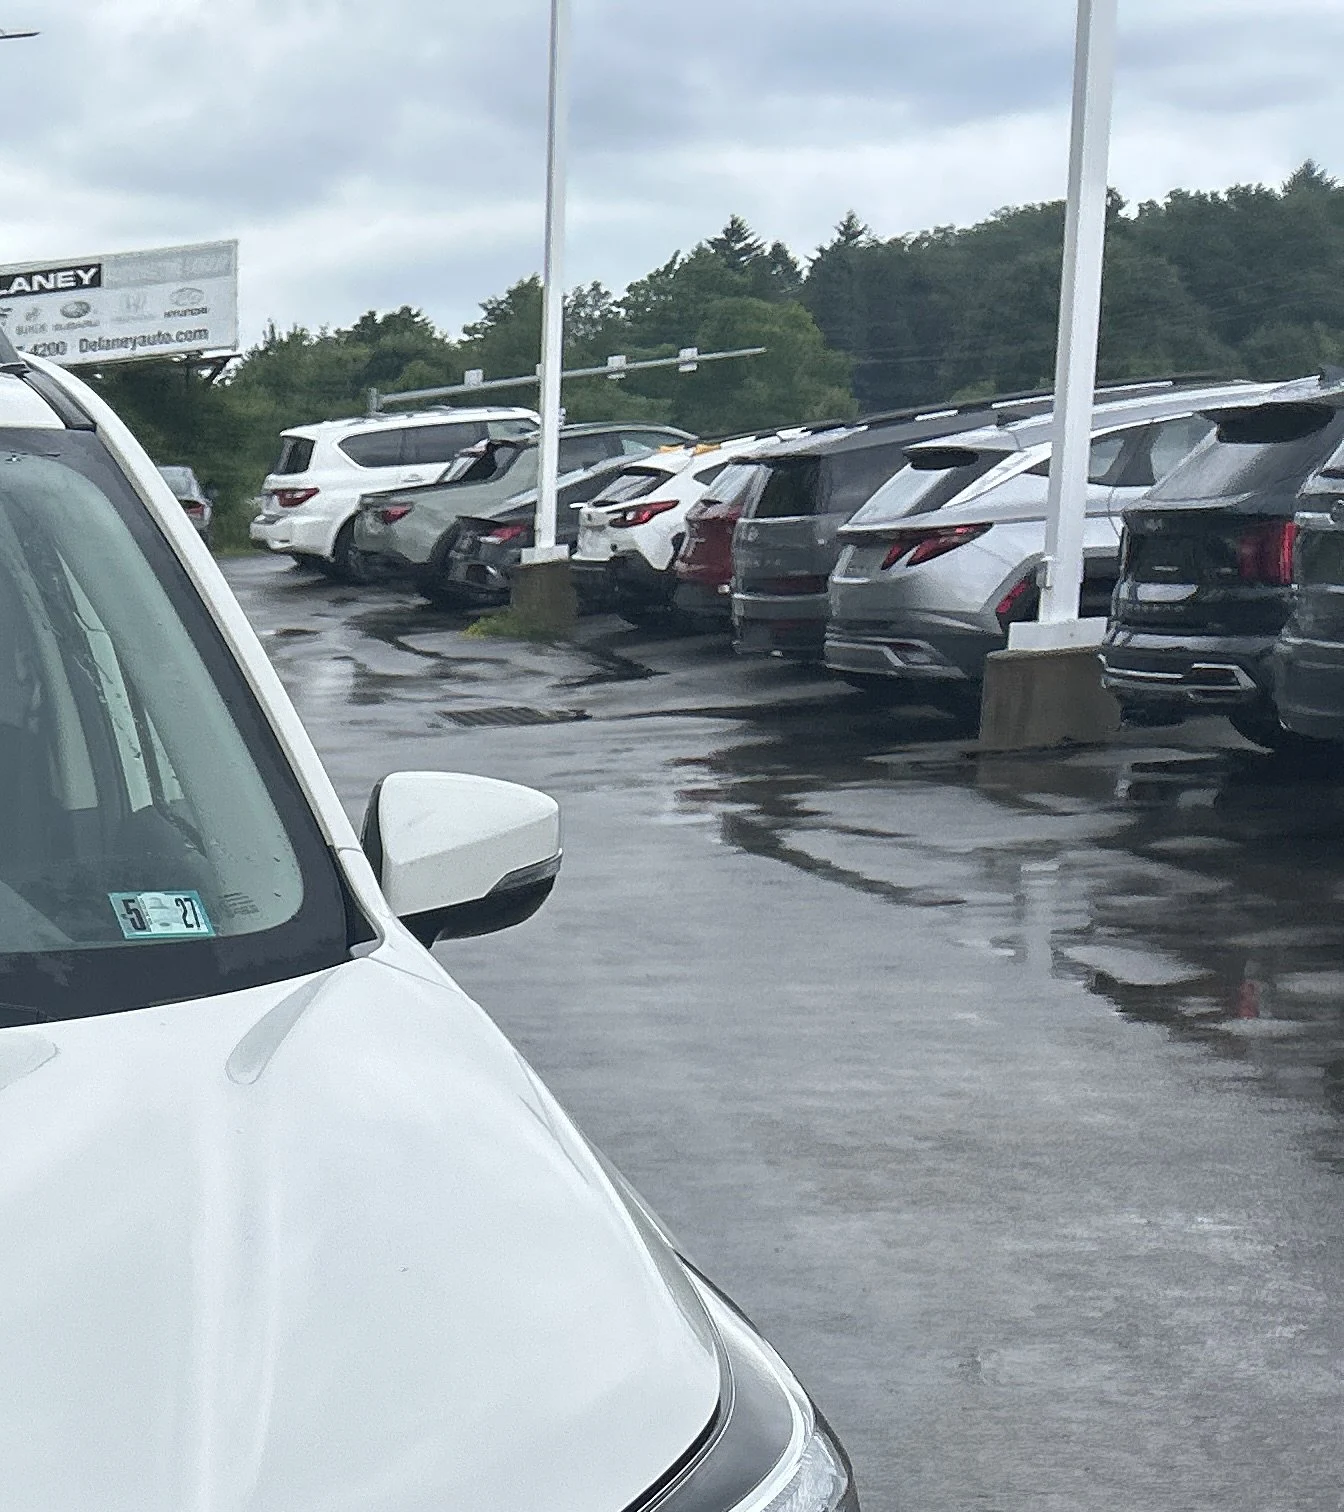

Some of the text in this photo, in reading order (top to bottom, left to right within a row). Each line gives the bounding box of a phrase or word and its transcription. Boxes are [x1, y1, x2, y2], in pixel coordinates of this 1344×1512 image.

[79, 328, 209, 353] Delaneyauto.com
[121, 897, 201, 930] 5 27
